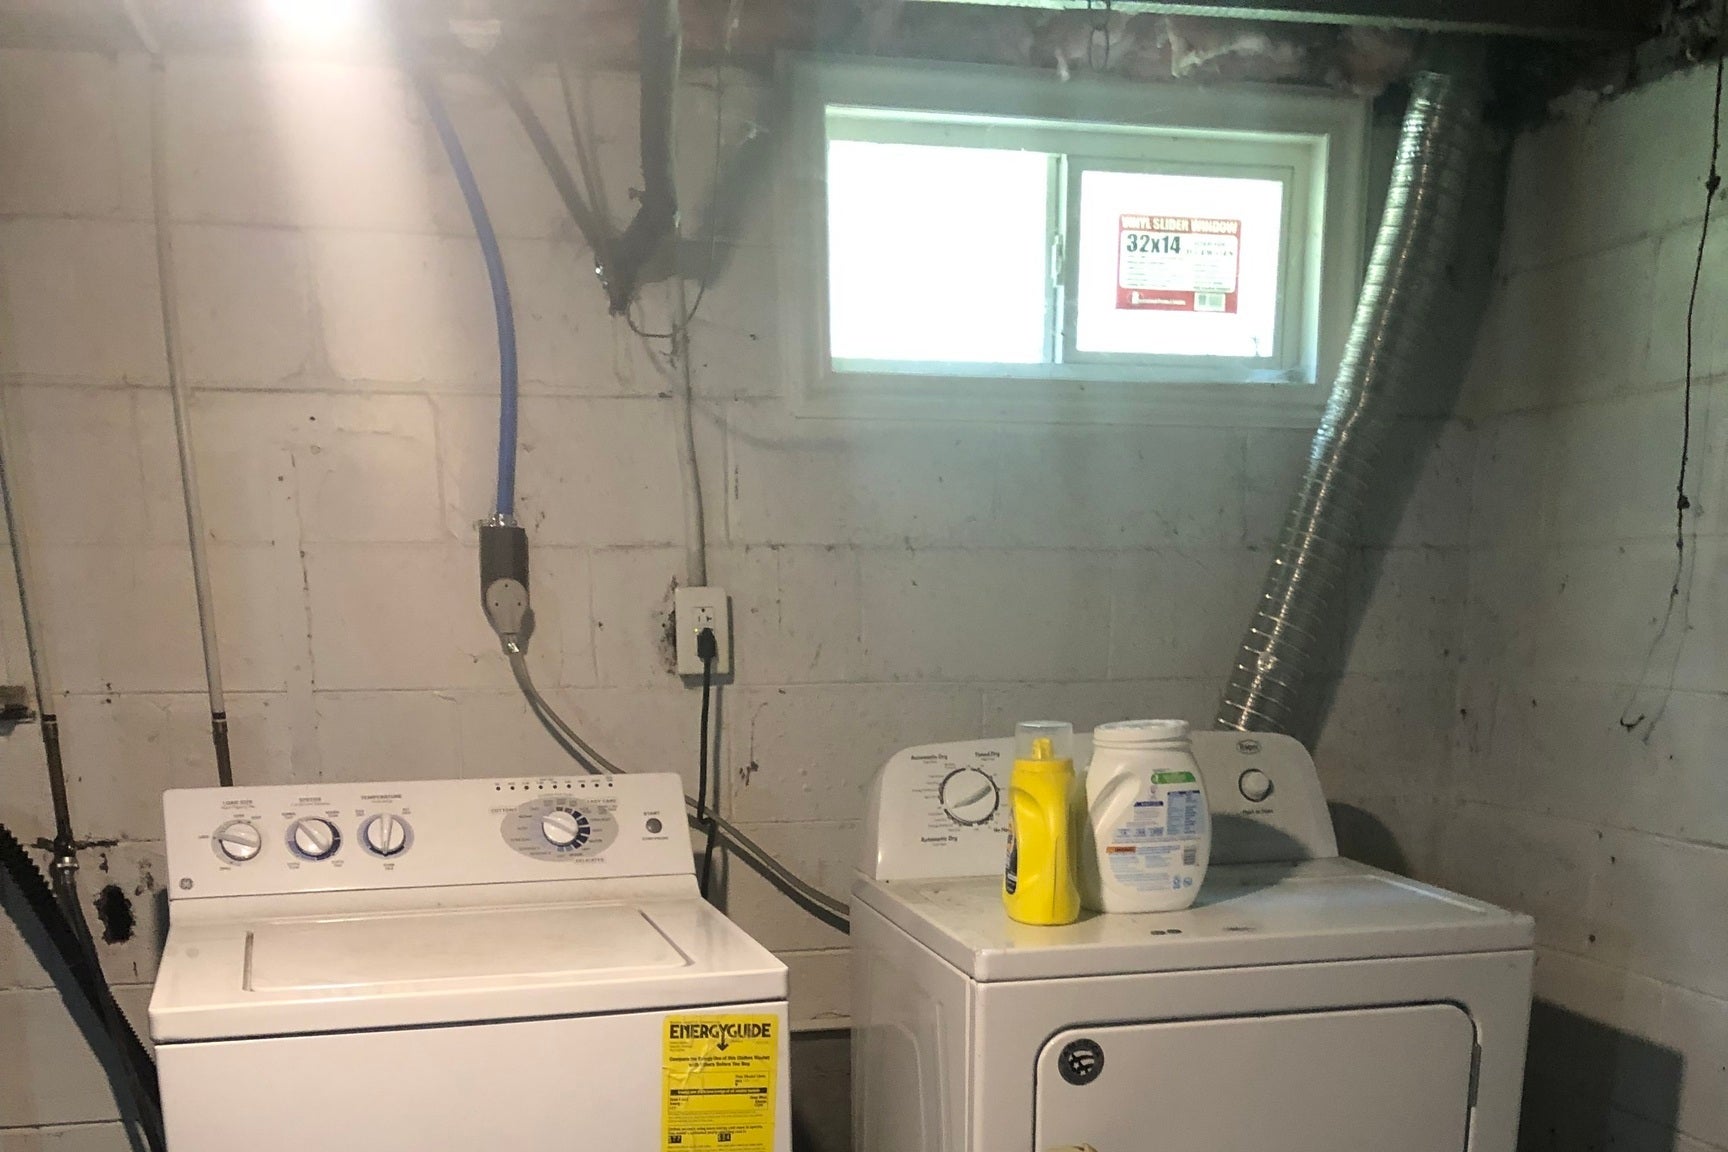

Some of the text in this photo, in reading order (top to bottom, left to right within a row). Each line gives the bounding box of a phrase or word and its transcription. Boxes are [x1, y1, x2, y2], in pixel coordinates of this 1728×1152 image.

[1152, 217, 1190, 232] SLIDER
[1127, 233, 1181, 254] 32x14
[669, 1023, 771, 1039] ENERGYGUIDE
